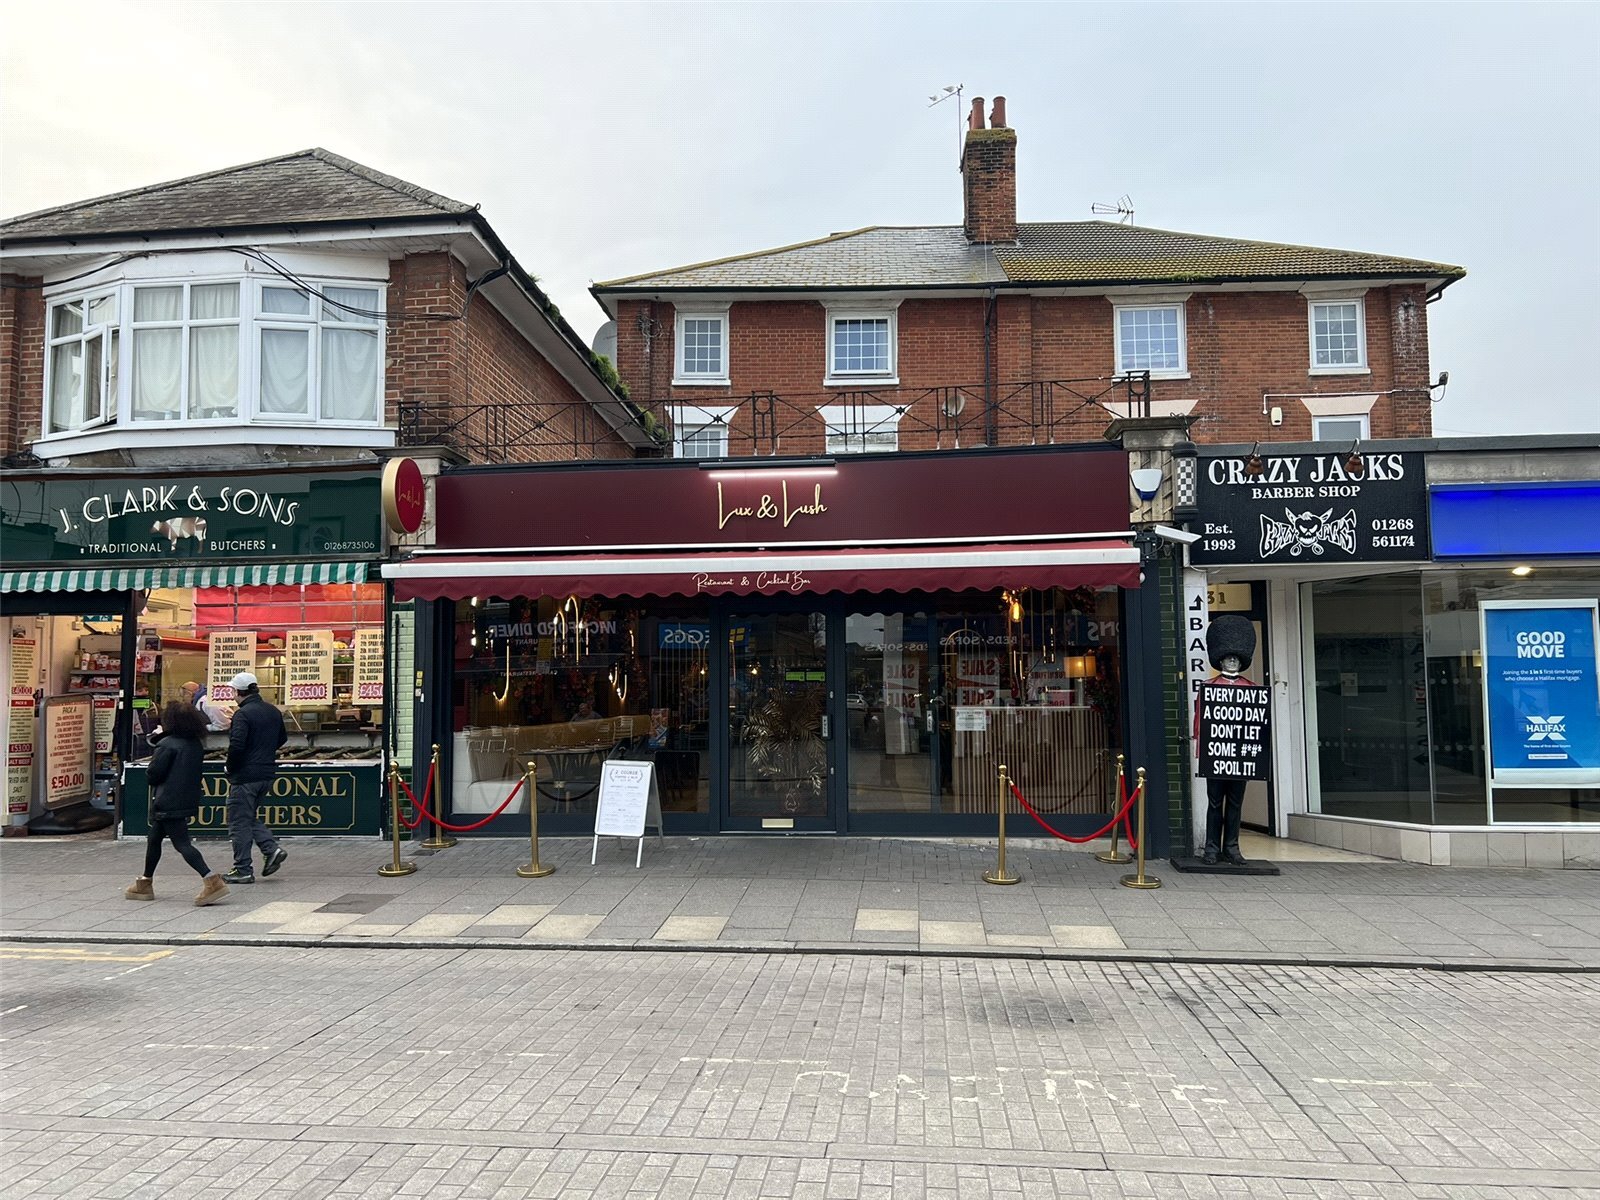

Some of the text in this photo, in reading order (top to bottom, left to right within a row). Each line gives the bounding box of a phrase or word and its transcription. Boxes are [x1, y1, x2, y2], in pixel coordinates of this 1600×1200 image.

[1252, 485, 1361, 500] BARBER SHOP
[59, 484, 301, 534] J. CLARK & SONS
[717, 479, 828, 530] Lux & Lush
[1204, 523, 1233, 535] Est.
[1372, 518, 1414, 531] 01268
[88, 540, 266, 554] TRADITIONAL BUTCHERS
[323, 541, 376, 551] 01268735106
[1203, 539, 1236, 551] 1993
[1372, 535, 1415, 548] 561174
[740, 576, 750, 586] &
[756, 571, 790, 589] Cocktail
[790, 570, 811, 591] Bar
[1207, 591, 1227, 605] 31
[1516, 631, 1566, 645] GOOD
[1517, 645, 1565, 659] MOVE
[213, 687, 234, 699] £63.
[1204, 687, 1268, 705] EVERY DAY IS
[1203, 705, 1268, 725] A GOOD DAY,
[1210, 723, 1261, 740] DON'T LET
[1526, 724, 1566, 733] HALIFAX
[1208, 742, 1236, 757] SOME
[1213, 760, 1256, 776] SPOIL IT!
[52, 773, 84, 789] £50.00
[201, 776, 347, 797] ADONAL
